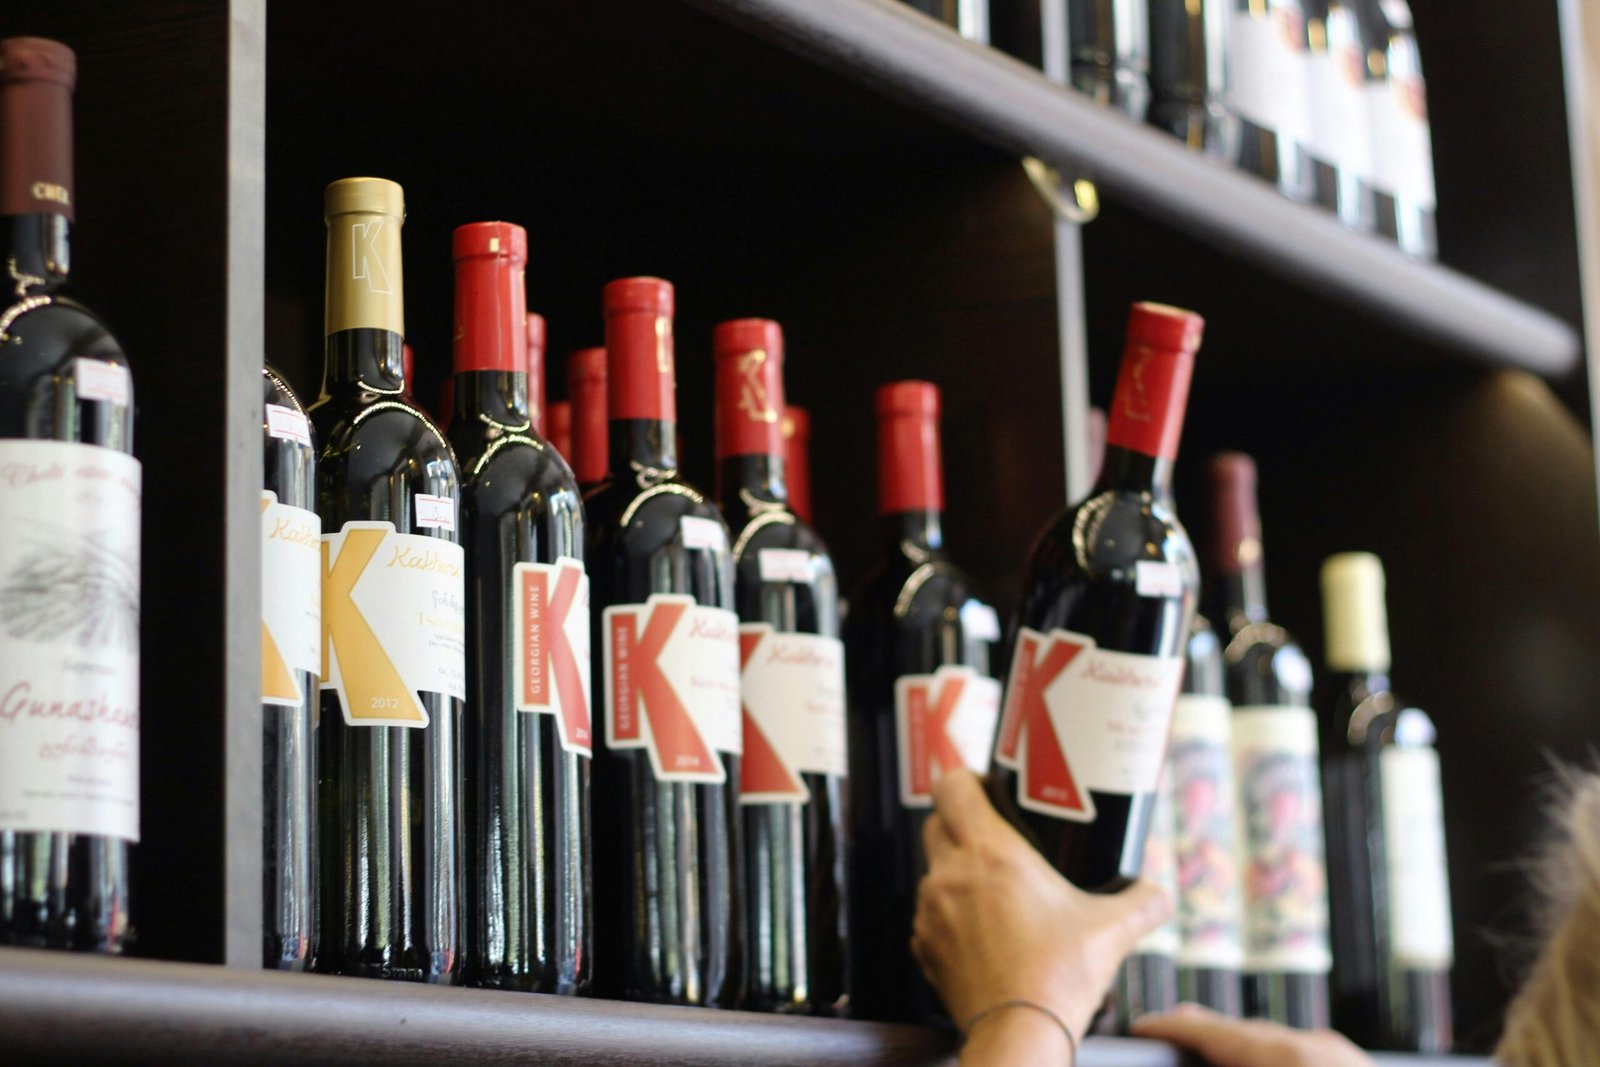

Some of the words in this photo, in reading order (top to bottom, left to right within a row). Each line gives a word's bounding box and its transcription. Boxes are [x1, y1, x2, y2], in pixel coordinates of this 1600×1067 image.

[352, 220, 393, 295] K
[529, 585, 540, 619] WINE
[522, 566, 591, 748] K
[530, 624, 541, 694] GEORGIAN
[611, 603, 719, 773] K
[370, 697, 400, 709] 2012
[1001, 636, 1086, 812] K
